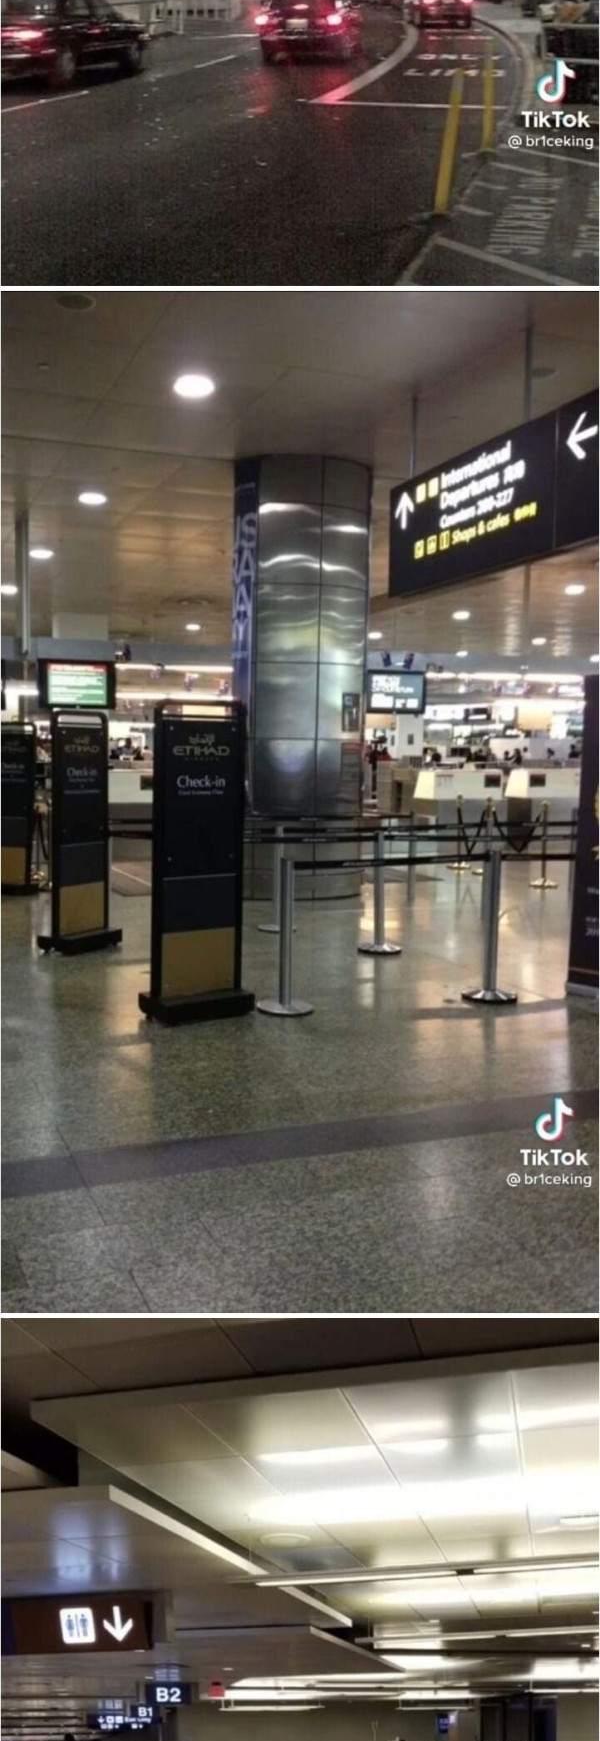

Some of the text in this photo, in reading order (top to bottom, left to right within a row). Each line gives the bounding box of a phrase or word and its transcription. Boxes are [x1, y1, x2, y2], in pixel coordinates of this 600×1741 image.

[441, 439, 512, 490] International
[440, 471, 500, 510] Departures
[451, 525, 476, 545] Shops
[173, 746, 230, 756] ETIHAD
[177, 775, 226, 788] Check-in
[156, 1687, 182, 1702] B2
[138, 1707, 153, 1717] B1
